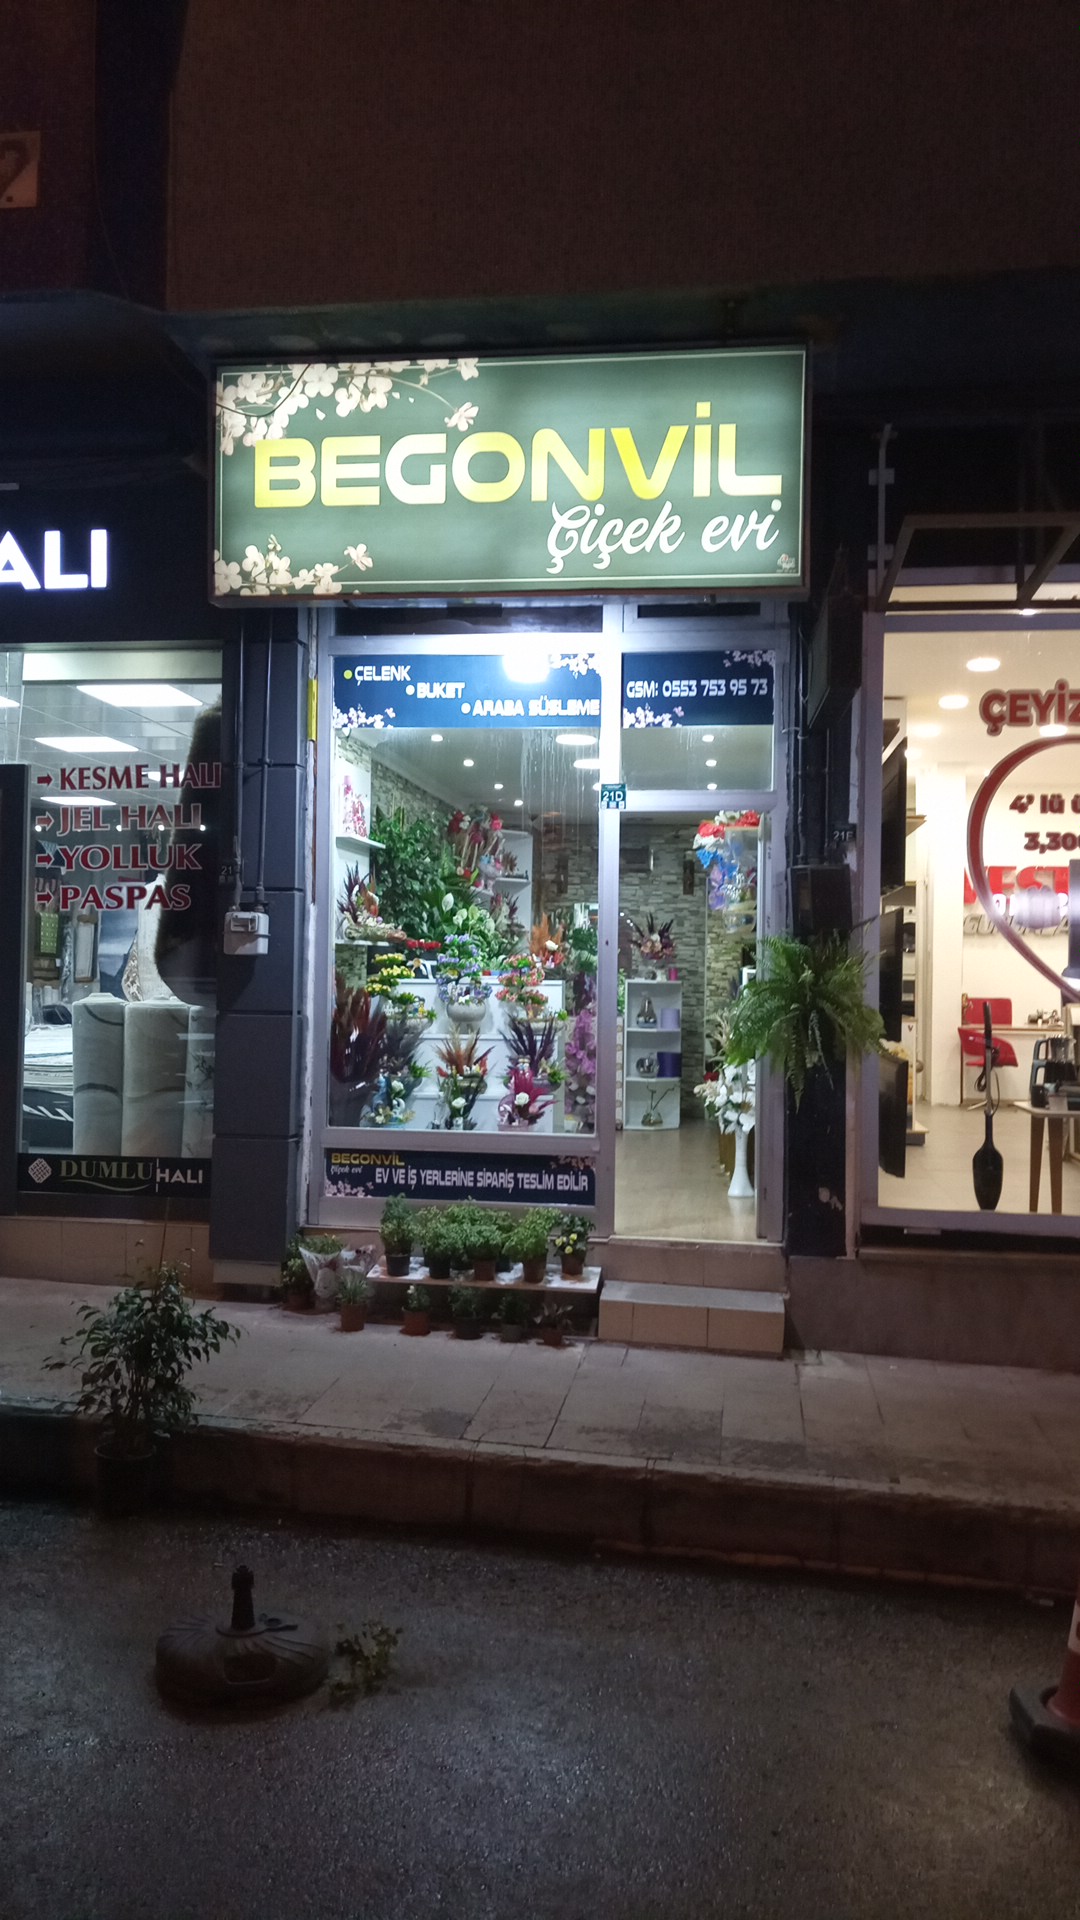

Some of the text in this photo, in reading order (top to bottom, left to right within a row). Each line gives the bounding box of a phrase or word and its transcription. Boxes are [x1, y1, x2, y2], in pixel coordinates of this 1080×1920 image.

[254, 401, 782, 508] BEGONVİL
[546, 499, 781, 574] Çiçek evi
[0, 529, 107, 590] ALI
[354, 665, 411, 686] ÇELENK
[626, 678, 768, 698] GSM: 0553 753 95 73
[417, 682, 465, 699] BUKET
[473, 697, 600, 717] ARABA SÜSLEME
[979, 679, 1080, 736] ÇEYİZ
[59, 762, 222, 791] KESME HALI
[602, 790, 624, 802] 21D
[58, 803, 202, 836] JEL HALI
[1023, 831, 1080, 854] 3,30
[59, 843, 202, 871] YOLLUK
[60, 884, 191, 911] PASPAS
[60, 1159, 203, 1184] DUMLU HALI
[331, 1151, 405, 1167] BEGONVİL
[375, 1165, 588, 1194] EV VE İŞ YERLERİNE SİPARİŞ TESLİM EDİLİR
